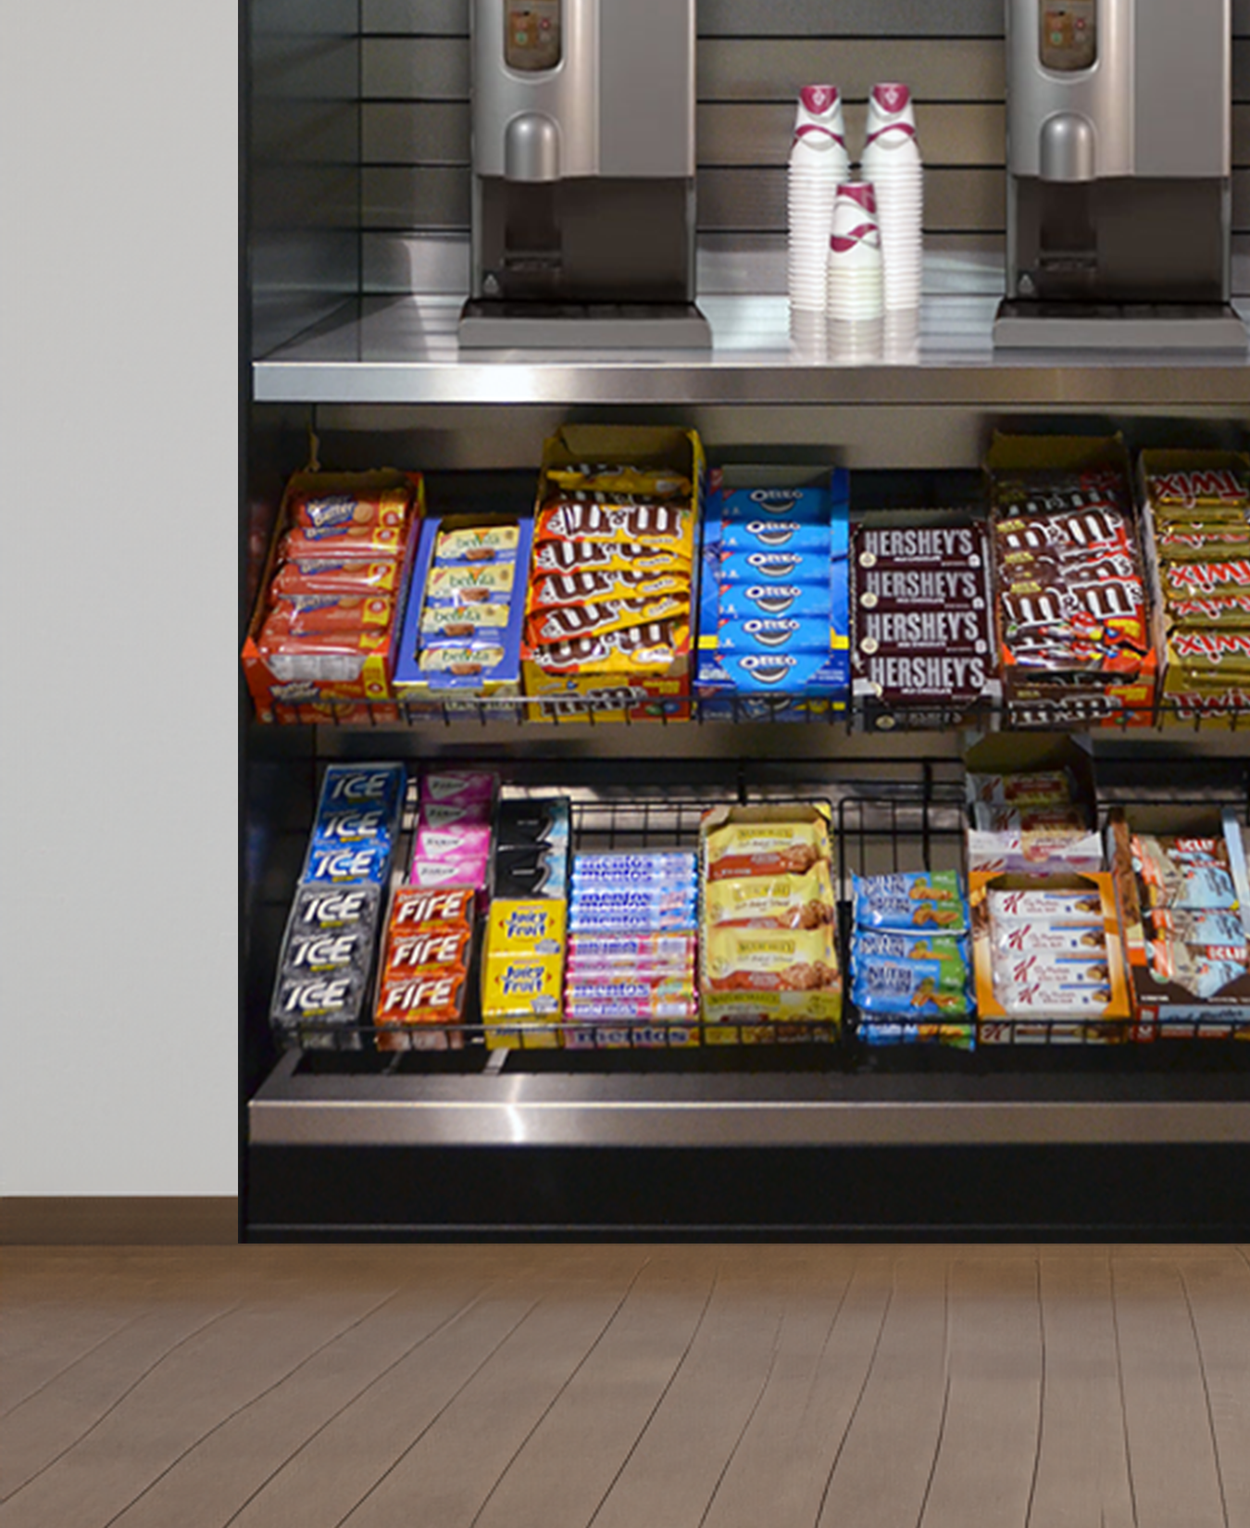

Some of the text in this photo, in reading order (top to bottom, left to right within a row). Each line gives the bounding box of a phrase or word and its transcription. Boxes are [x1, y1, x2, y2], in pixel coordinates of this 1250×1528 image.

[864, 529, 973, 556] HERSHEY'S
[867, 571, 977, 598] HERSHEY'S
[867, 611, 979, 642] HERSHEY'S
[871, 657, 985, 688] HERSHEY'S
[331, 772, 391, 800] ICE
[323, 811, 384, 839] ICE
[314, 848, 377, 878] ICE
[303, 891, 367, 922] ICE
[396, 891, 465, 923] FIRE
[292, 934, 358, 966] ICE
[391, 933, 461, 967] FIRE
[284, 978, 351, 1012] ICE
[383, 977, 456, 1012] FIRE
